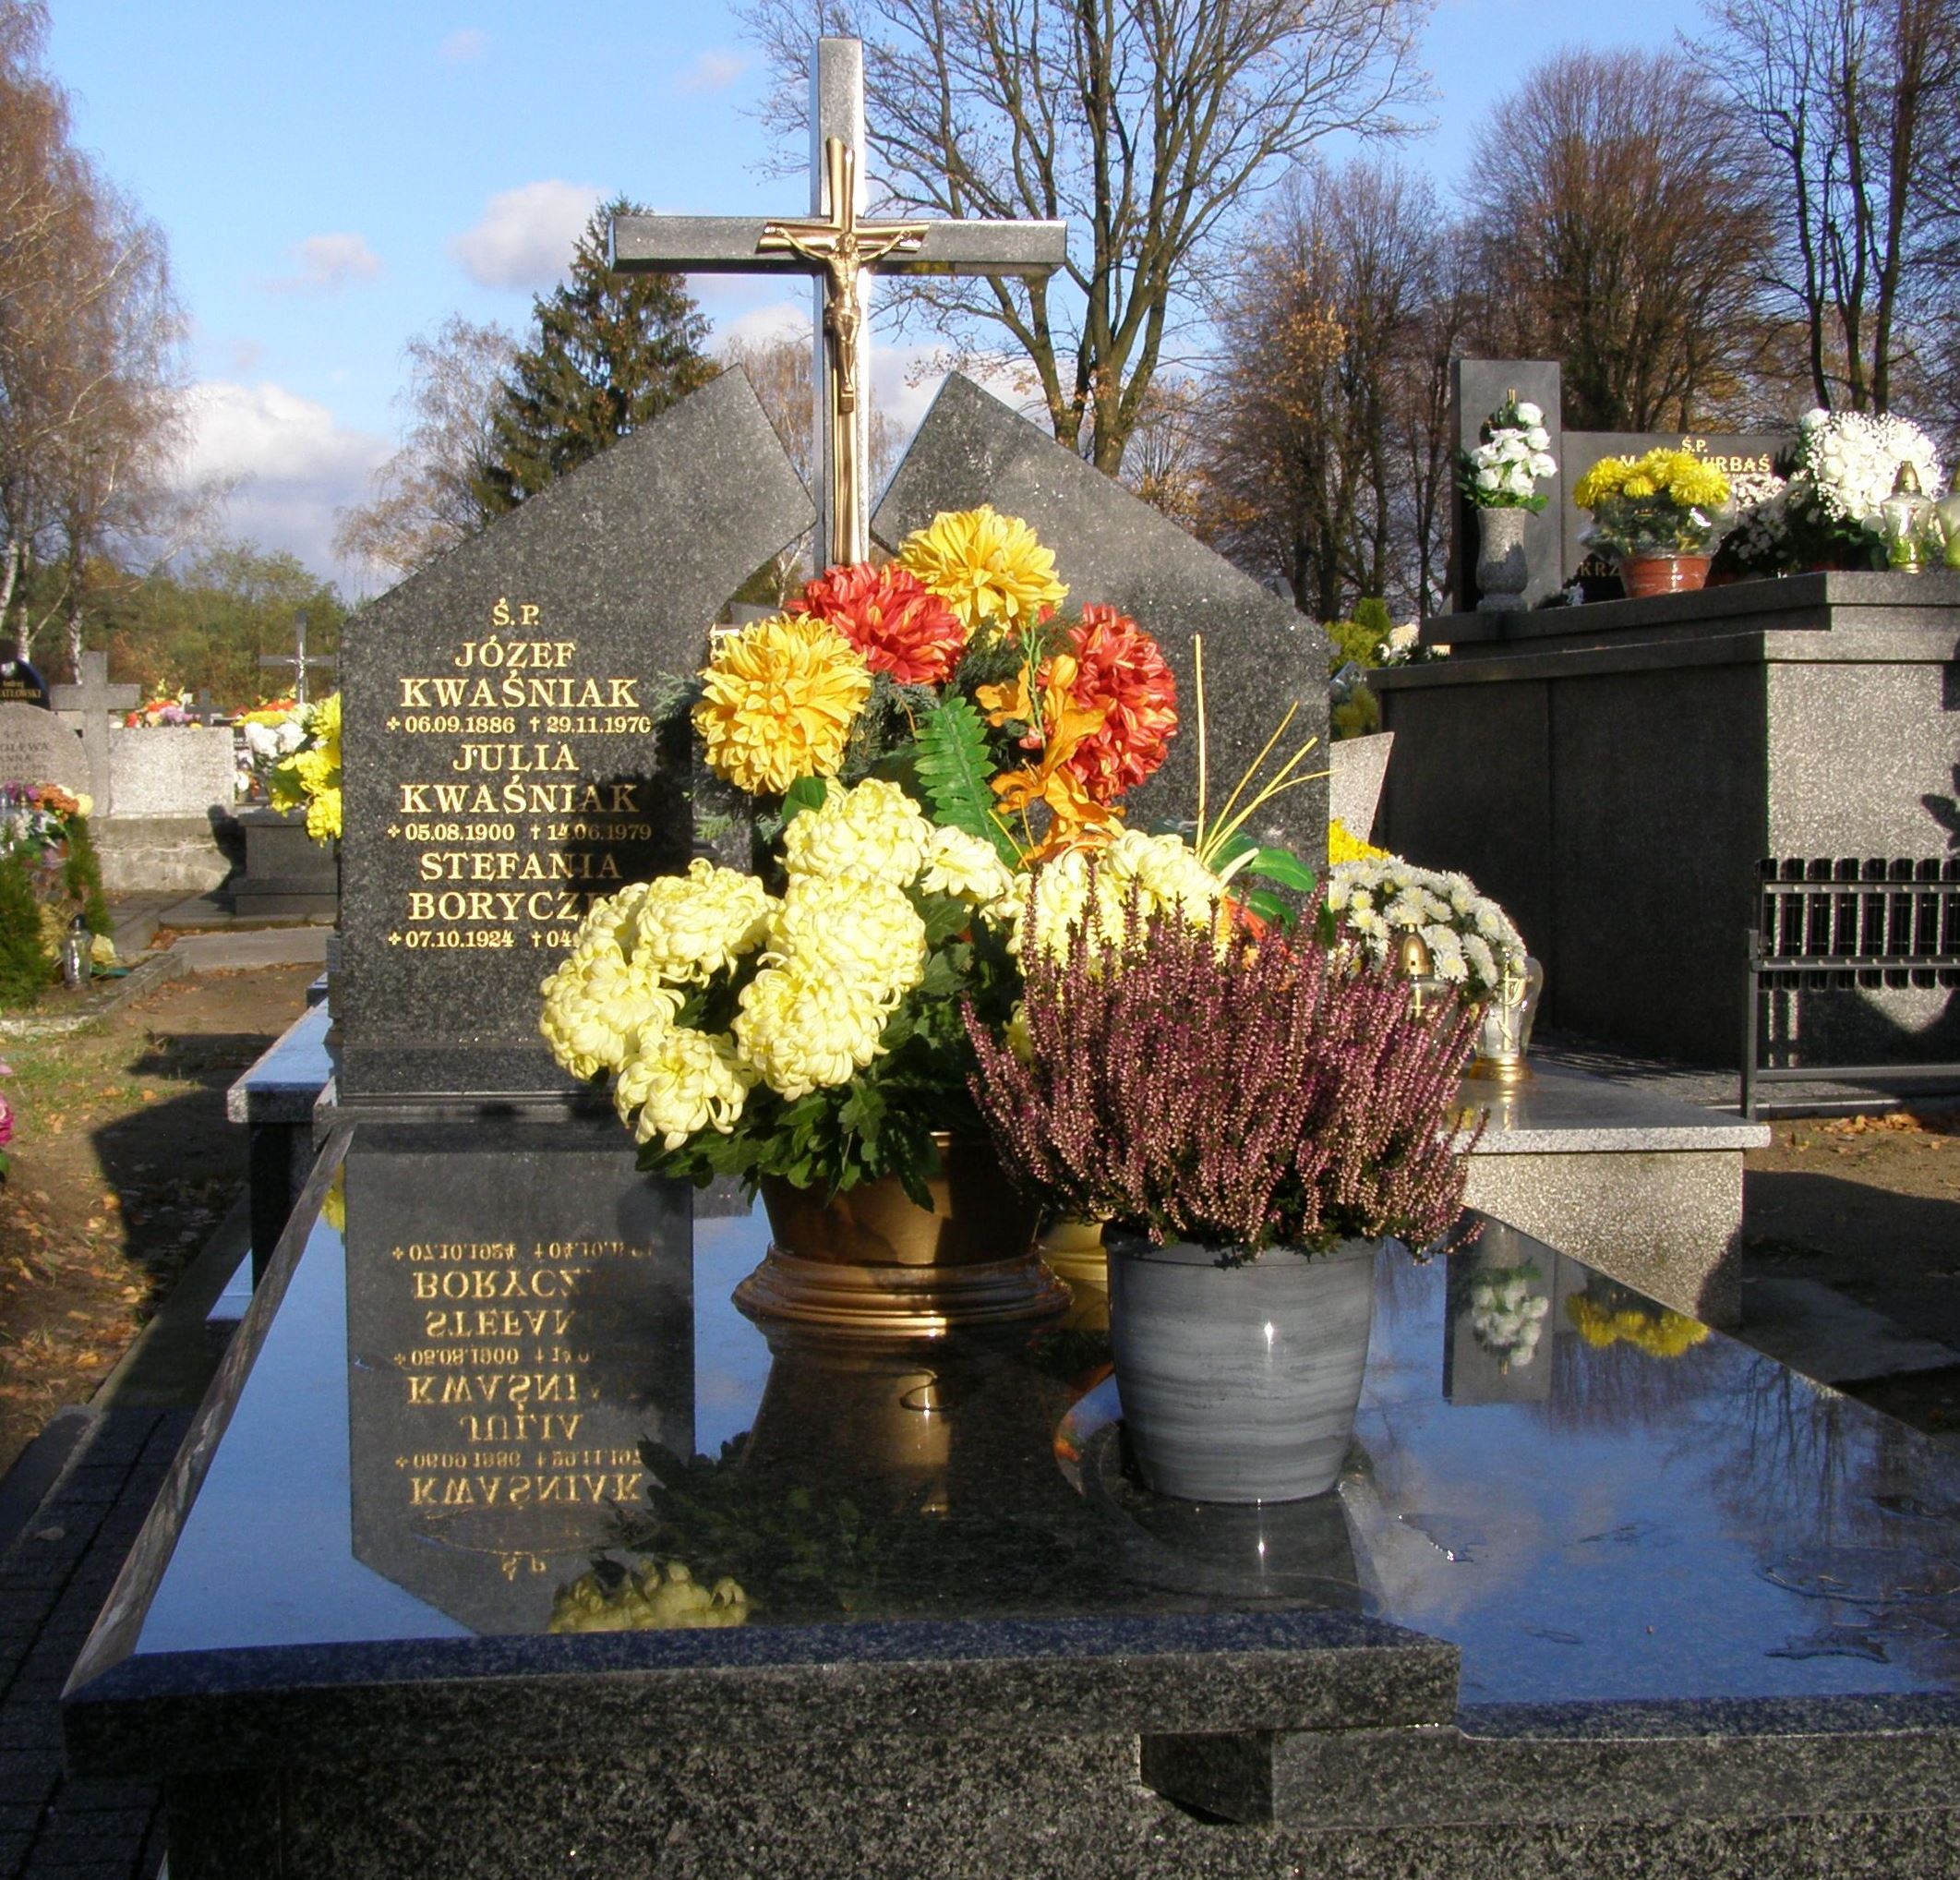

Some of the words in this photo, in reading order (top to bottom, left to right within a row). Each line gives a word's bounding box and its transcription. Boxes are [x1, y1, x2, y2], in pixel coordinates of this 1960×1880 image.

[454, 635, 577, 669] JÓZEF
[400, 669, 640, 709] KWAŚNIAK
[404, 715, 516, 734] 06.09.1886
[546, 716, 652, 734] 29.11.1970
[452, 743, 580, 772] JULIA
[400, 774, 641, 814] KWAŚNIAK
[404, 823, 516, 841] 05.08.1900
[420, 852, 623, 881] STEFANIA
[405, 931, 515, 949] 07.10.1924
